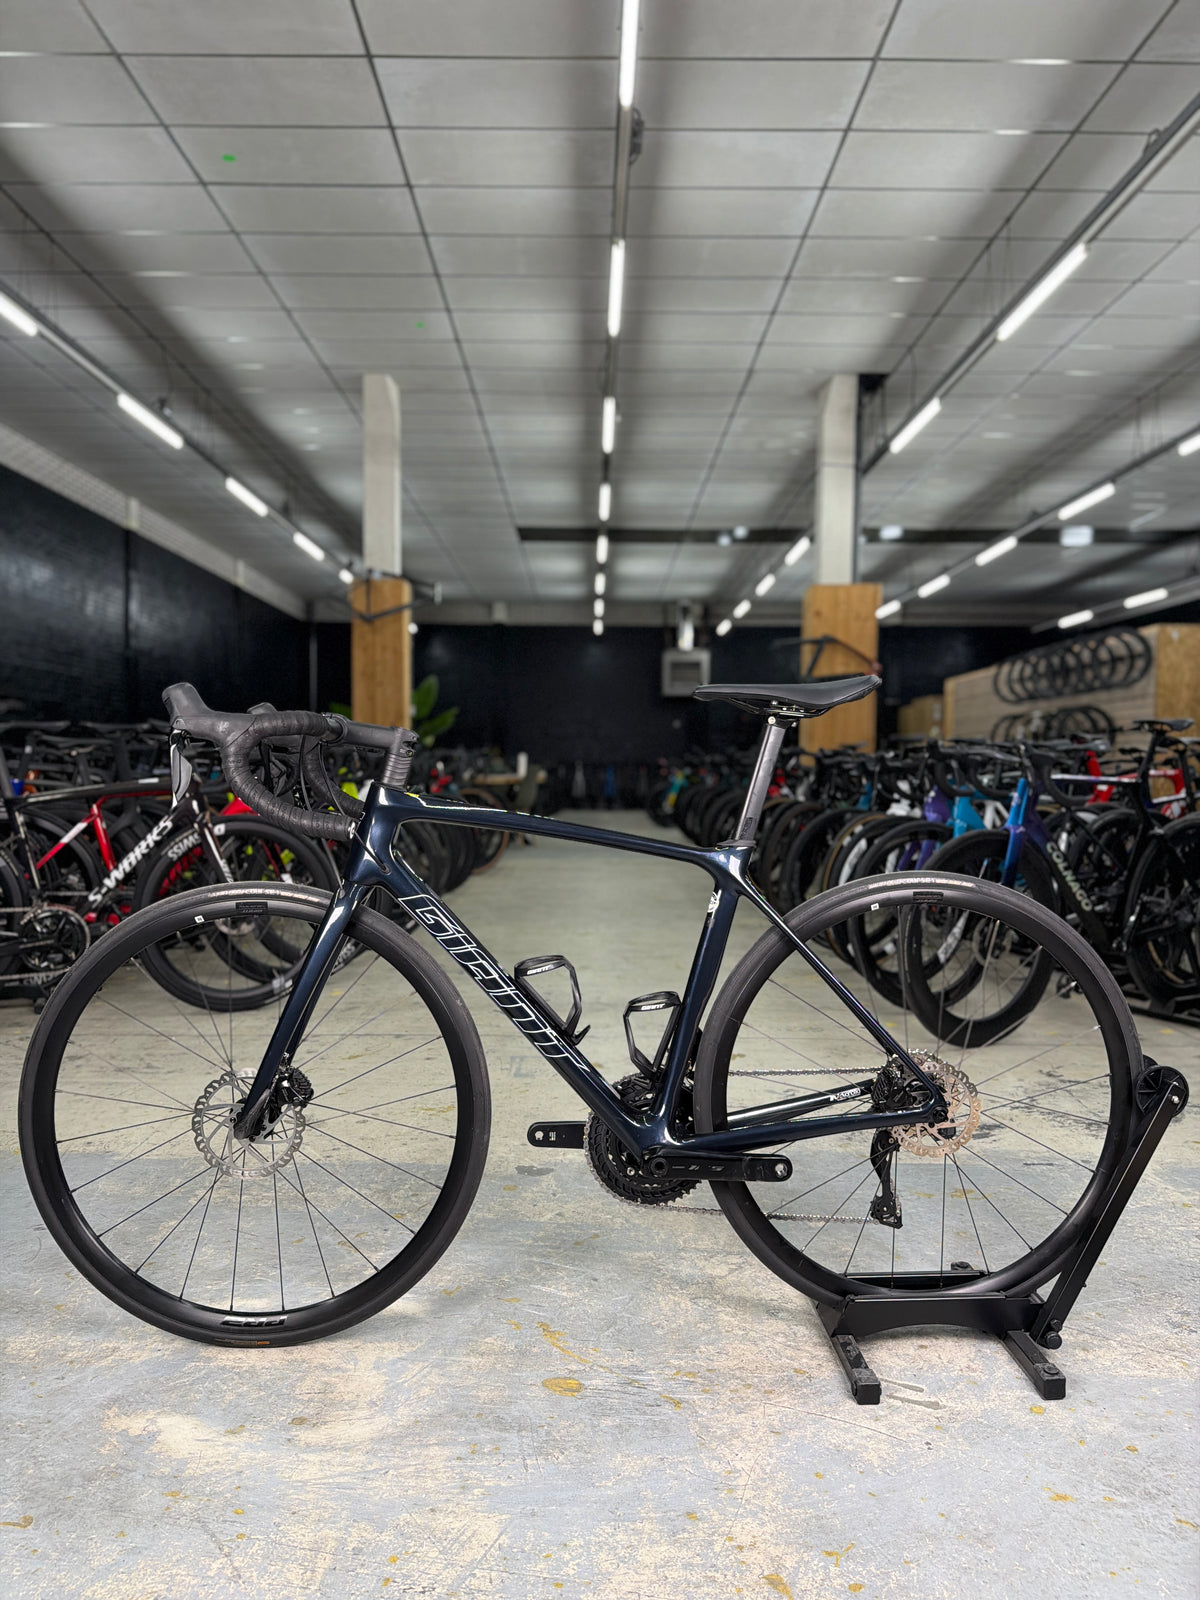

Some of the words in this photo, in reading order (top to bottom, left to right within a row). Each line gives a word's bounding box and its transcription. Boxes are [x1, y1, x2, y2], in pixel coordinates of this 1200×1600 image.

[88, 815, 174, 908] S-WORKS
[1046, 841, 1093, 911] COLNAGO
[398, 894, 591, 1072] GIANT
[527, 964, 552, 975] GIANT
[641, 1003, 666, 1011] GIANT
